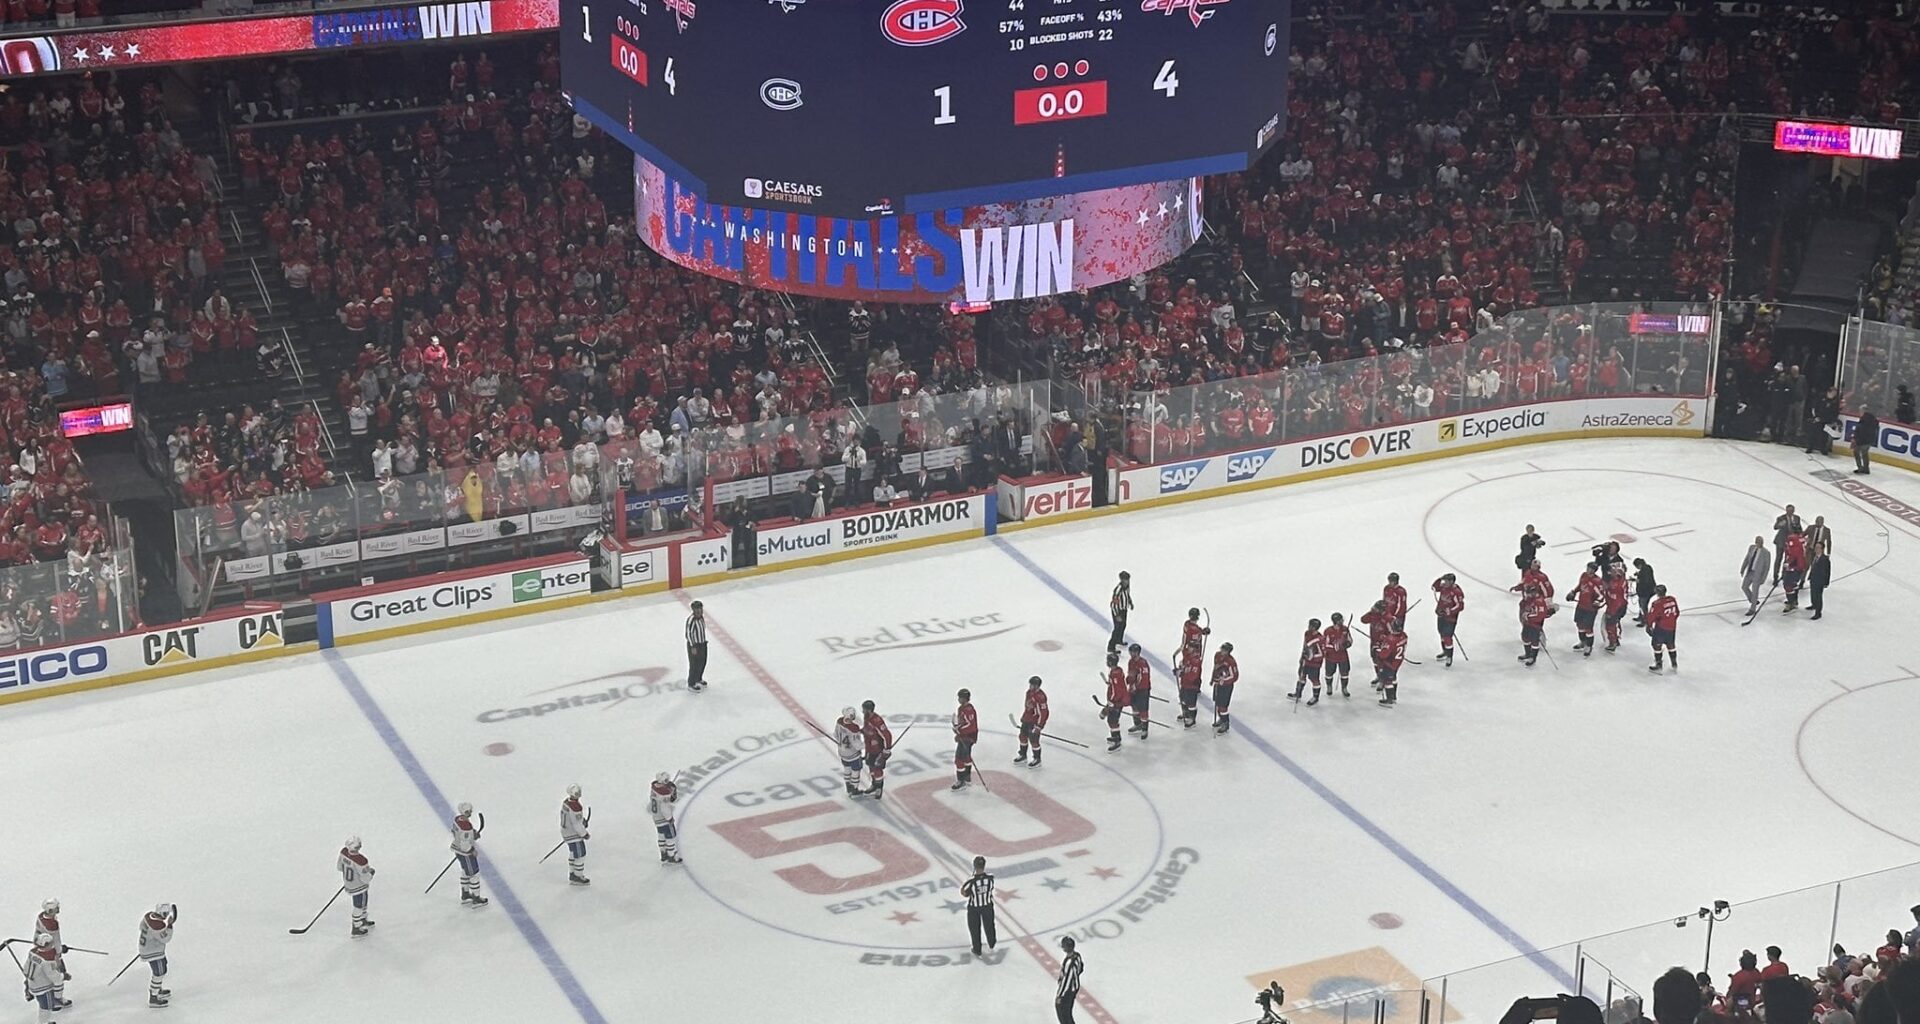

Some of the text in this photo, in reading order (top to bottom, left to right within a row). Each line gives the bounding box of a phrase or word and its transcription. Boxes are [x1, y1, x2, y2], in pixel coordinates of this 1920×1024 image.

[418, 1, 492, 39] WIN
[582, 5, 593, 43] 1
[999, 20, 1024, 33] 57%
[1040, 13, 1075, 25] FACEOFF
[1097, 9, 1122, 22] 43%
[1009, 29, 1113, 51] 10 BLOCKED SHOTS 22
[620, 45, 638, 75] 0.0
[664, 57, 676, 96] 4
[1153, 60, 1179, 97] 4
[934, 86, 956, 125] 1
[1038, 90, 1083, 118] 0.0
[1850, 127, 1899, 158] WIN
[764, 180, 822, 197] CAESARS
[765, 192, 812, 204] SPORTSBOOK
[724, 221, 863, 257] WASHINGTON
[960, 219, 1074, 302] WIN
[1677, 315, 1705, 332] WIN
[101, 408, 129, 427] WIN
[1160, 409, 1673, 488] SAP SAP DISCOVER Expedia AstraZeneca
[625, 499, 651, 512] EICO
[842, 500, 970, 539] BODYARMOR
[759, 528, 831, 556] sMutual
[843, 533, 898, 548] SPORTS DRINK
[518, 570, 590, 593] enter
[622, 561, 650, 576] se
[350, 583, 492, 622] Great Clips
[143, 627, 200, 666] CAT
[816, 612, 1003, 653] Red River
[476, 687, 622, 723] Capital
[676, 726, 798, 797] pital One
[724, 748, 956, 808] capals
[707, 769, 1097, 895] 50
[1117, 846, 1200, 923] Capital
